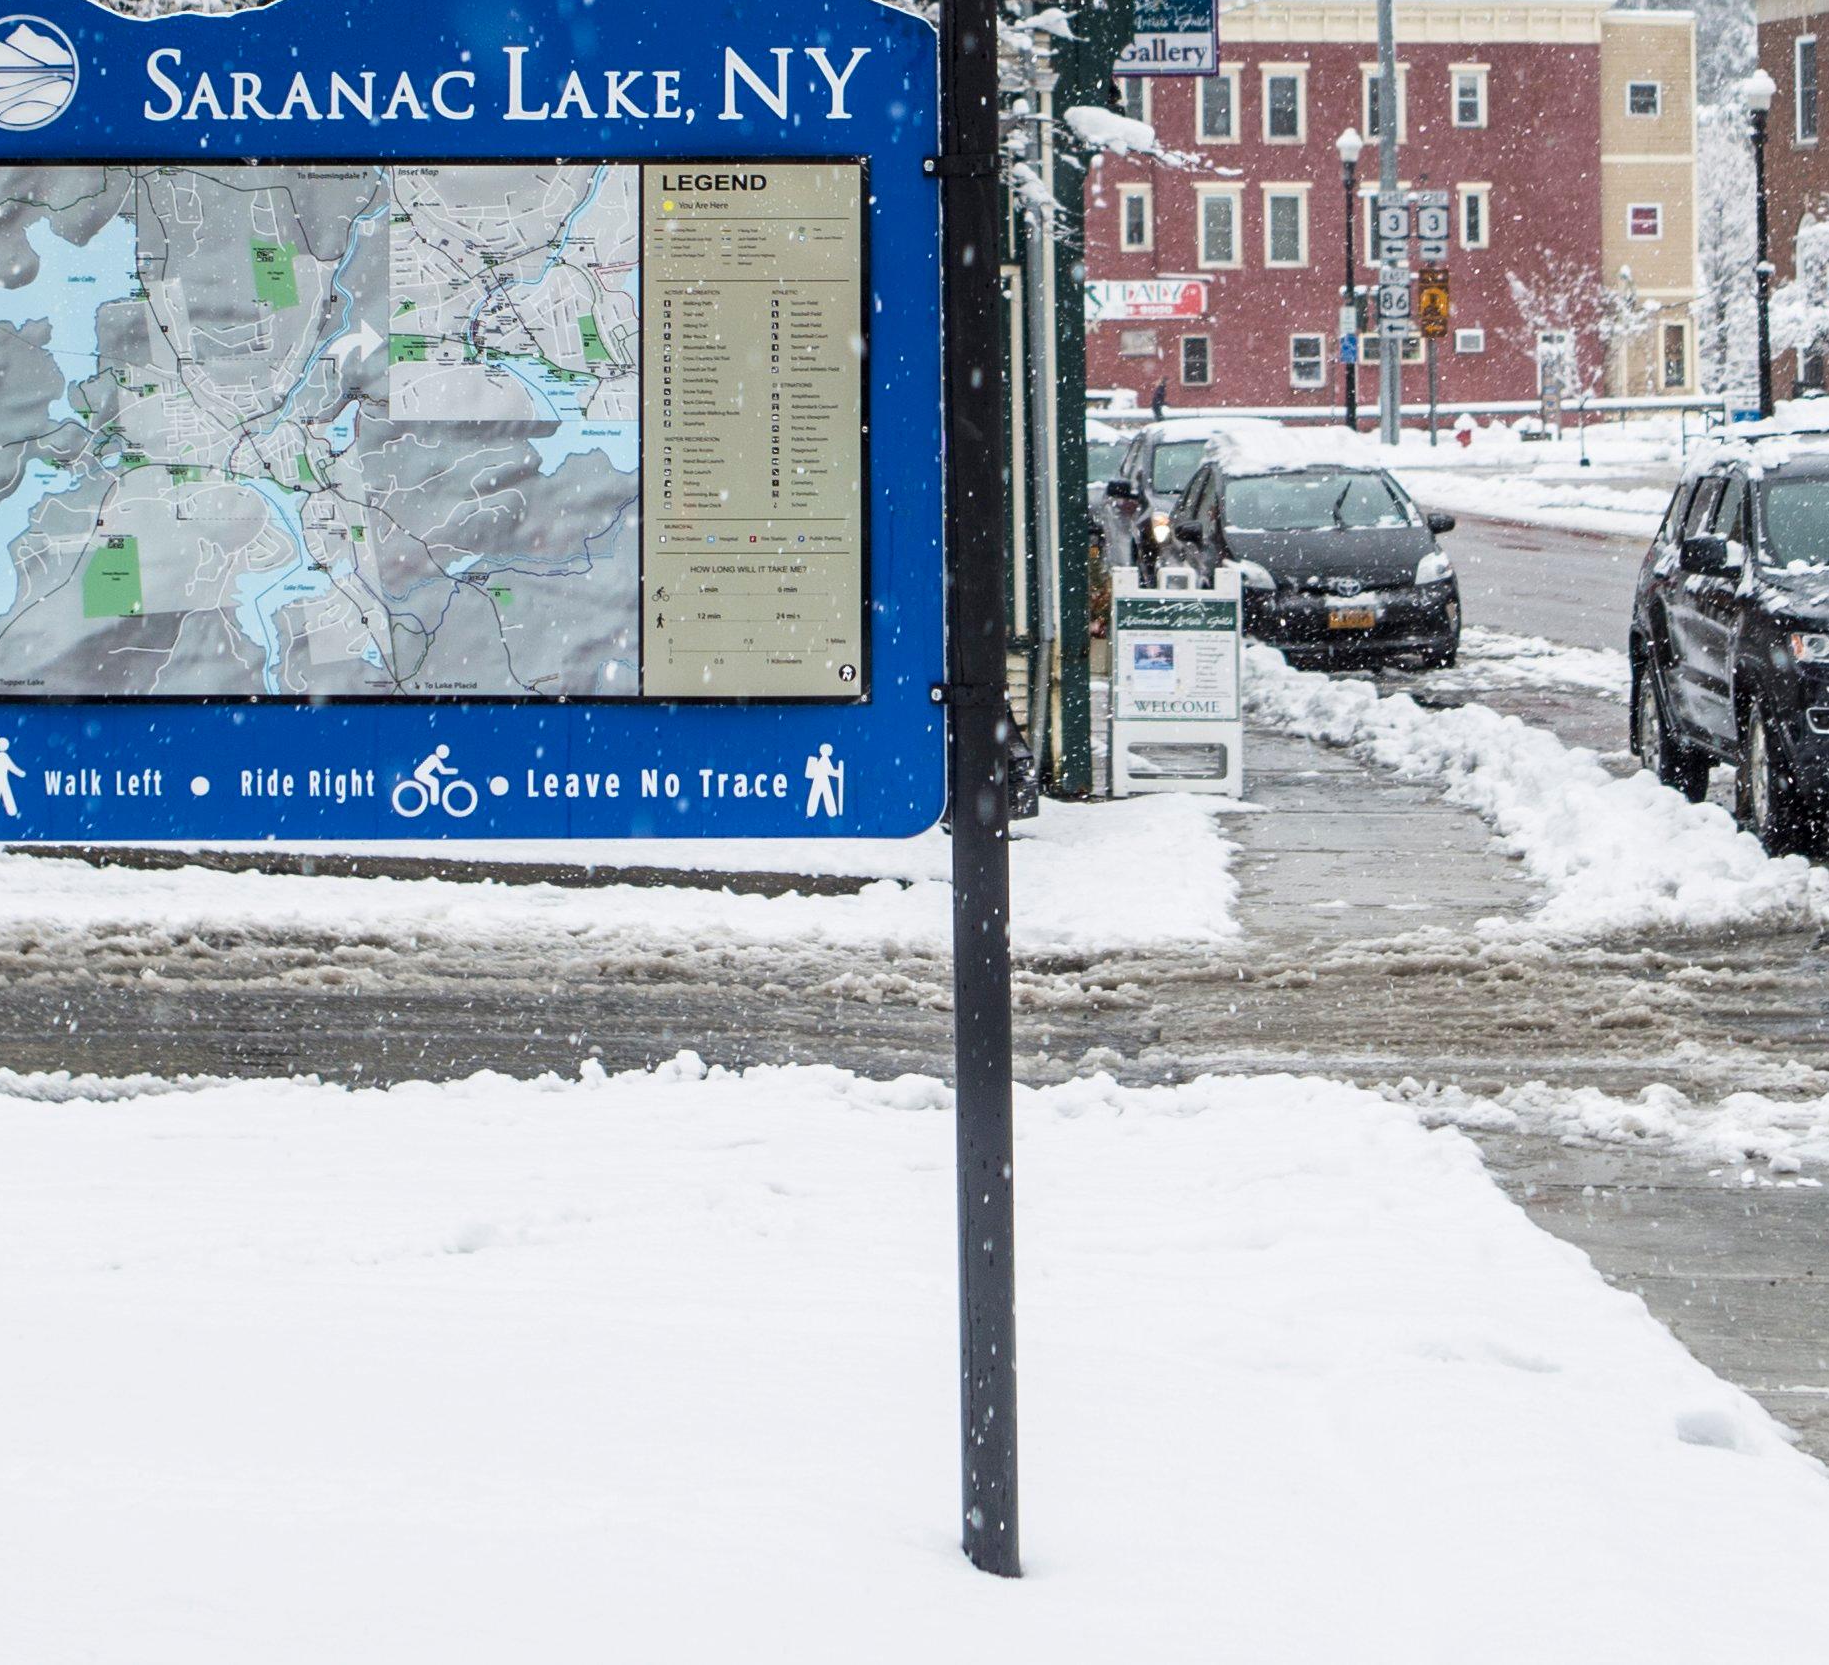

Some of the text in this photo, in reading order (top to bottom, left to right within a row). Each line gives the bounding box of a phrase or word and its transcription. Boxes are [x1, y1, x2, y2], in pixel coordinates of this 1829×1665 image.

[144, 46, 872, 122] SARANAC LAKE, NY
[297, 172, 359, 180] To Bloomingdale
[397, 167, 439, 176] Inset Map
[662, 174, 767, 191] LEGEND
[678, 201, 729, 210] You Are Here
[1388, 214, 1400, 232] 3
[1427, 214, 1440, 232] 3
[1382, 293, 1407, 311] 86
[0, 679, 25, 687] Tupper
[1134, 700, 1221, 714] WELCOME
[44, 769, 162, 797] Walk Left
[240, 769, 376, 802] Ride Right
[526, 769, 788, 798] Leave No Trace
